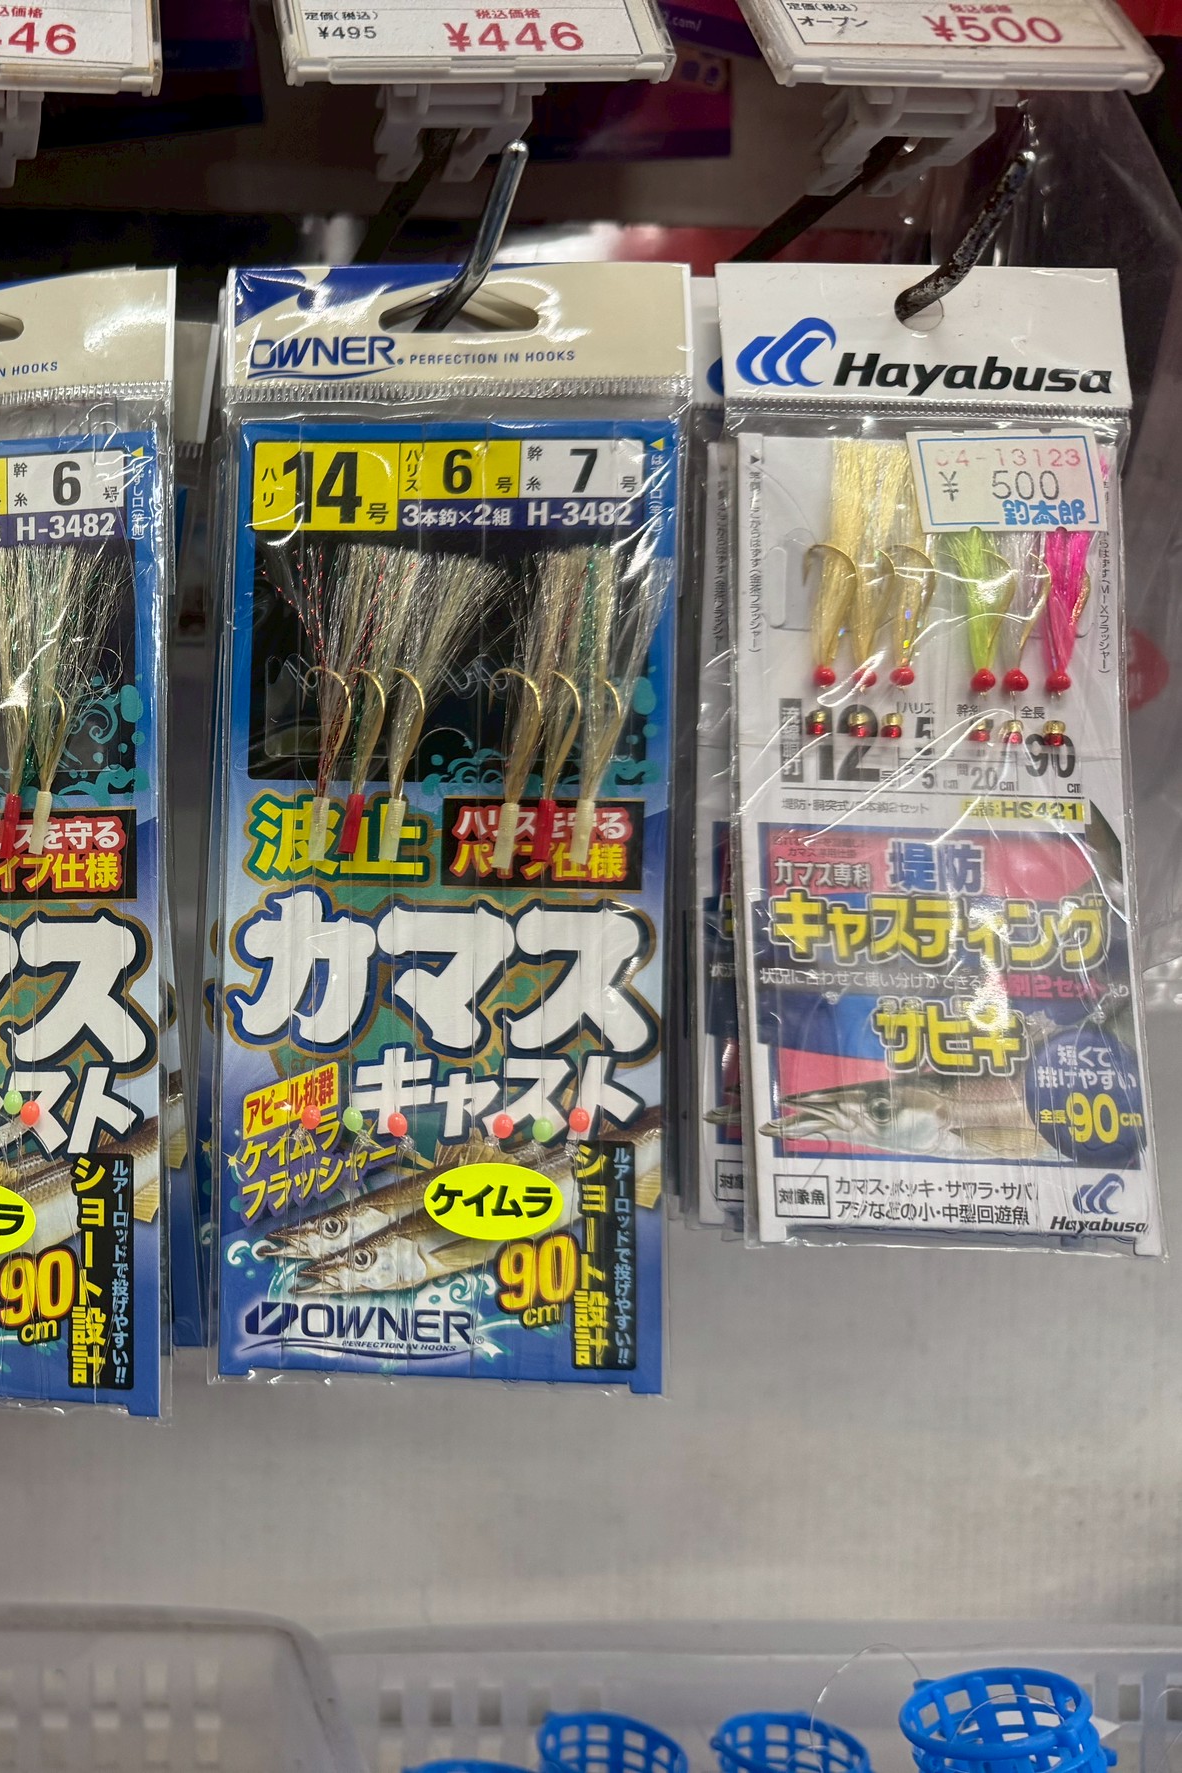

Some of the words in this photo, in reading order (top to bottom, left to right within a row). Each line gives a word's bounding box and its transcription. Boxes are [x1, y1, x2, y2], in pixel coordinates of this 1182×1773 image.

[474, 9, 541, 20] 税込価格
[797, 16, 869, 30] オープン
[317, 25, 378, 40] ¥495
[442, 22, 585, 53] ¥446
[923, 15, 1065, 45] ¥500
[252, 336, 396, 368] OWNER
[410, 353, 498, 367] PERFECTION
[503, 352, 519, 364] IN
[525, 349, 576, 363] HOOKS
[11, 361, 58, 375] HOOKS
[833, 352, 1113, 396] Hayabusa
[261, 467, 278, 509] ハリ
[17, 512, 116, 541] H-3482
[526, 501, 634, 527] H-3482
[1002, 499, 1087, 527] 釣太郎
[1021, 706, 1046, 720] 全長
[255, 801, 424, 876] 波止
[774, 859, 871, 888] カマス専科
[888, 841, 983, 893] 堤防
[773, 892, 1106, 964] キャスティング
[235, 890, 649, 1054] カマス
[1057, 1045, 1112, 1068] 短くて
[1037, 1066, 1137, 1090] 投げやすい
[353, 1048, 640, 1141] キャスト
[242, 1144, 398, 1221] フラッシャー
[430, 1183, 554, 1219] ケイムラ
[1050, 1216, 1149, 1235] Hayabusa
[72, 1158, 107, 1385] ショート設計
[574, 1148, 608, 1366] ショート設計
[0, 1252, 74, 1325] 90
[501, 1241, 576, 1308] 90
[21, 1318, 58, 1343] cm
[301, 1307, 474, 1346] OWNER
[522, 1306, 559, 1328] cm
[420, 1343, 458, 1353] HOOKS
